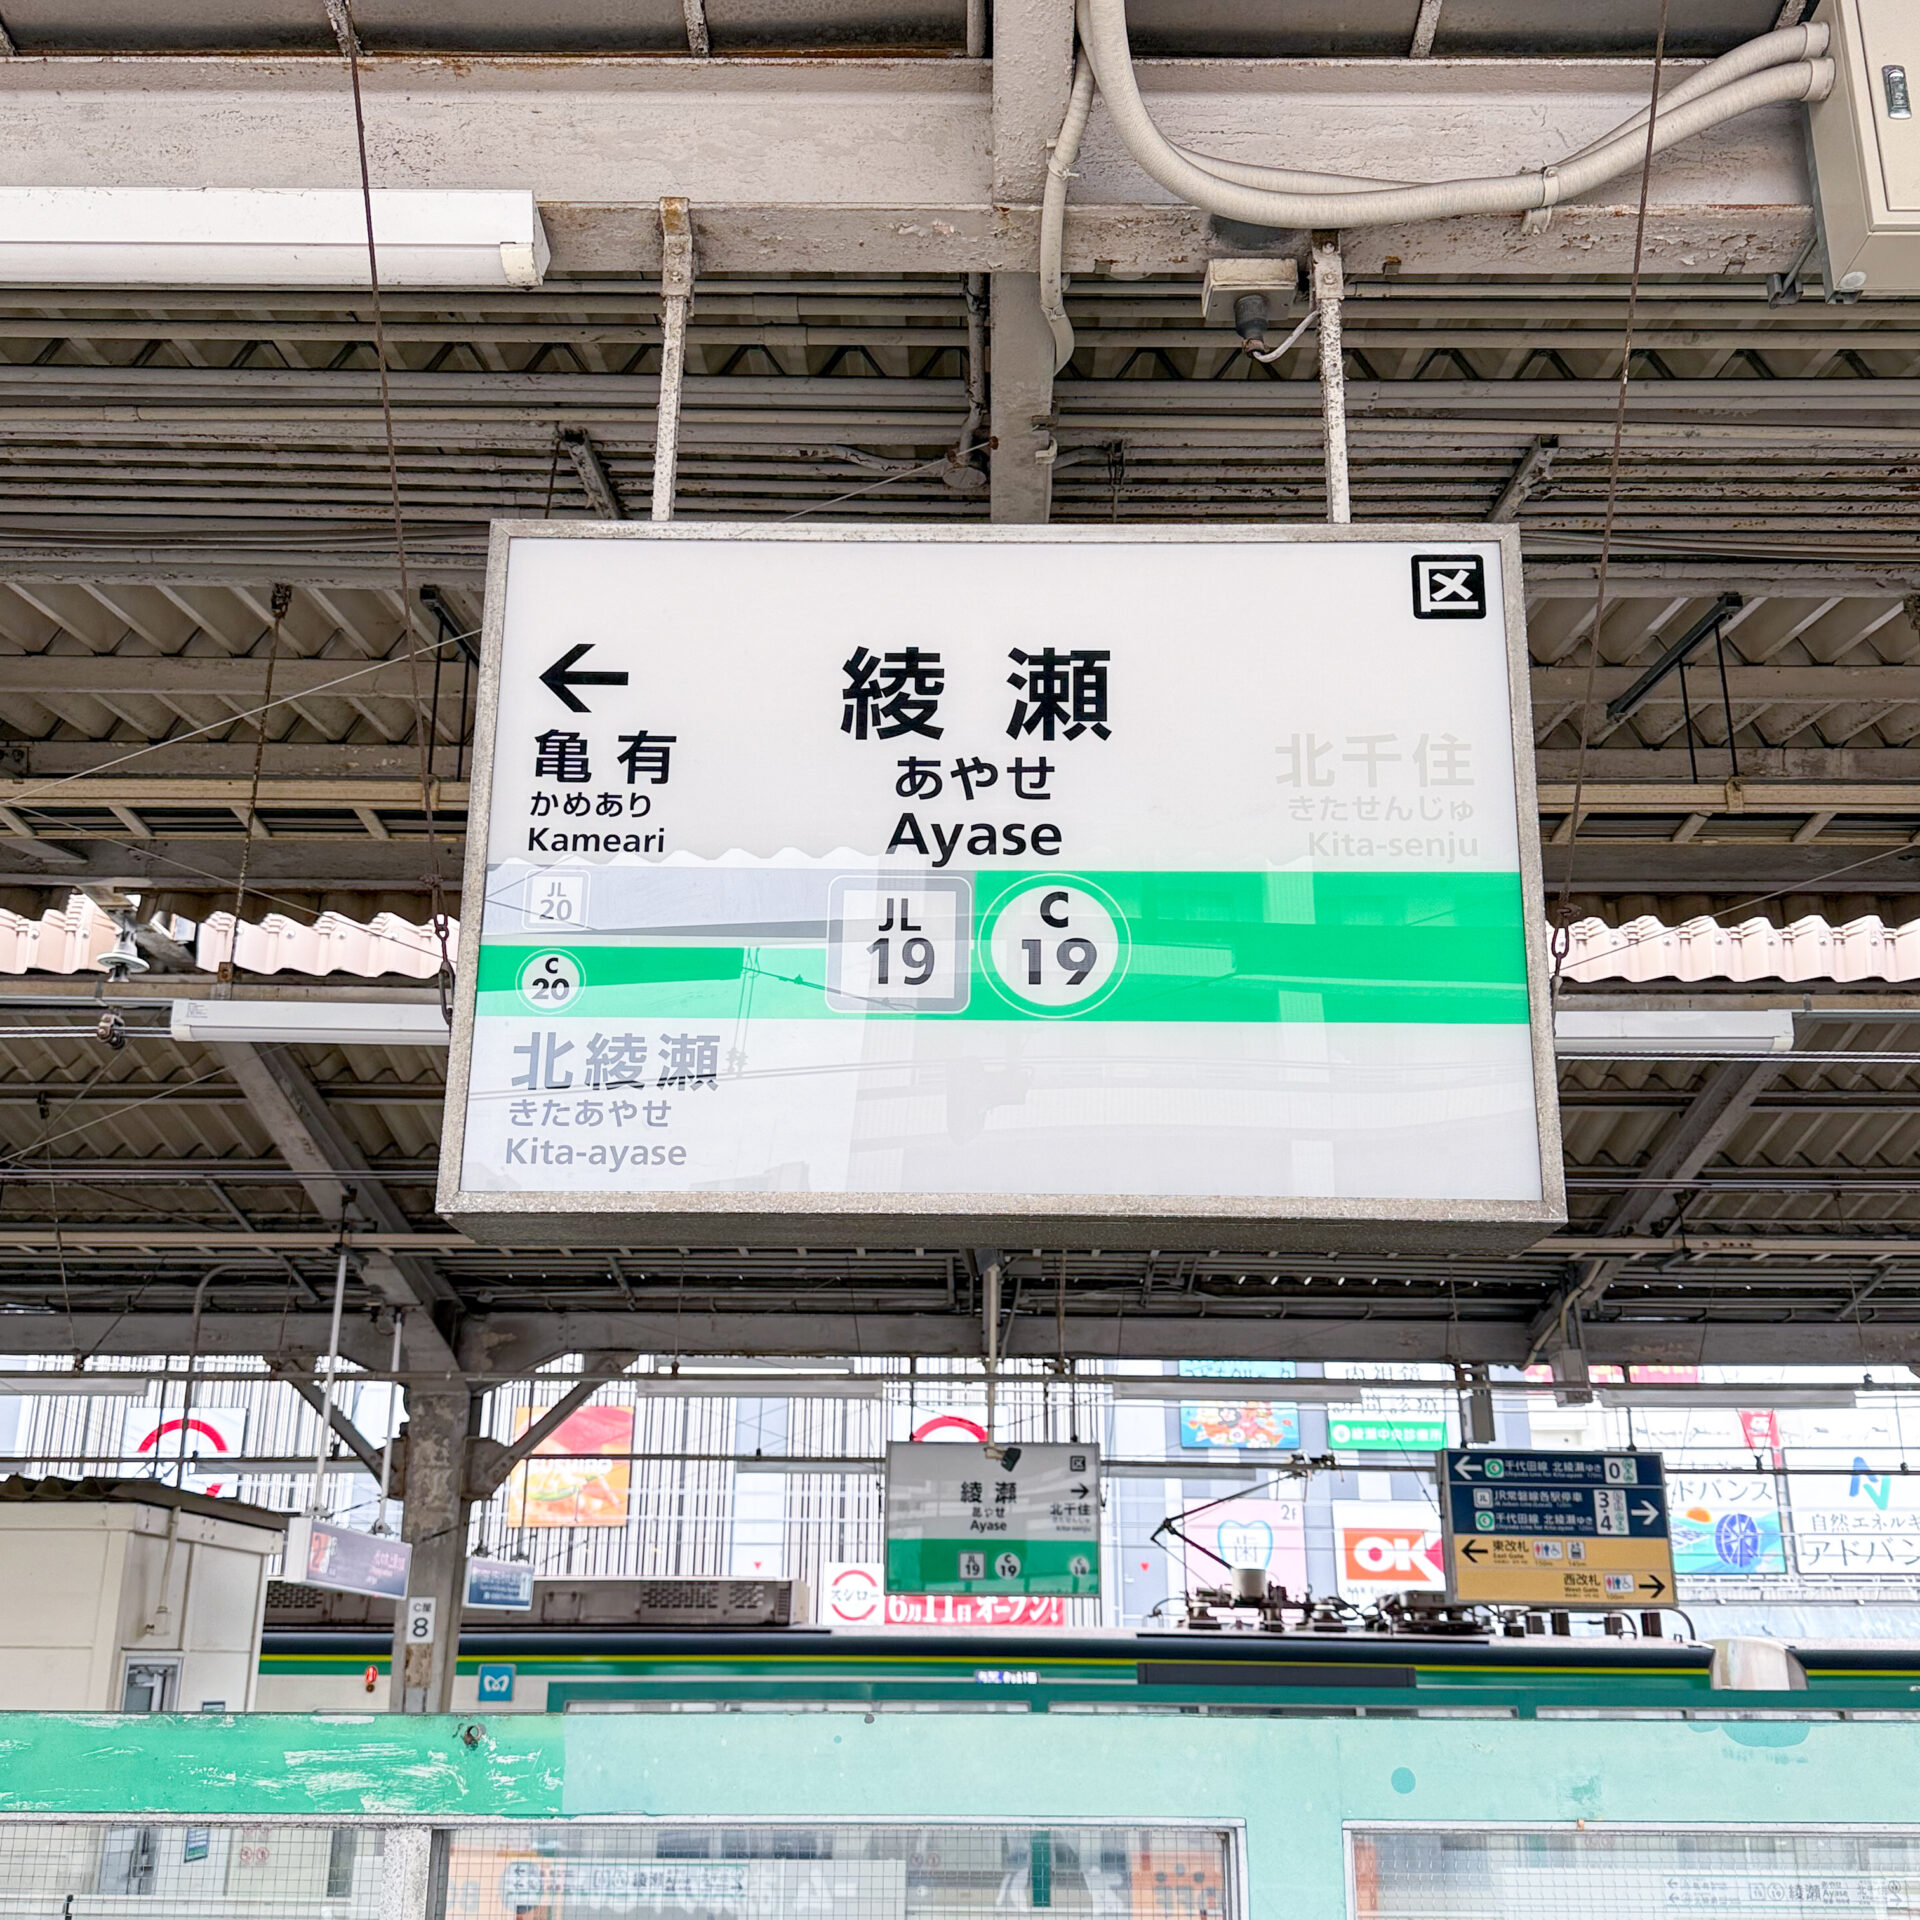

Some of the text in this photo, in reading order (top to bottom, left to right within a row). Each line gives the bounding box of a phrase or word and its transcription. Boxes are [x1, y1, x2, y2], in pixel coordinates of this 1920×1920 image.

[1415, 557, 1482, 616] 区
[840, 646, 1112, 741] 綾瀬
[534, 729, 677, 784] 亀有
[1274, 733, 1475, 788] 北千住
[895, 755, 1055, 801] あやせ
[529, 791, 651, 817] かめあり
[1288, 796, 1474, 822] きたせんじゅ
[528, 827, 665, 853] Kameari
[885, 812, 1063, 868] Ayase
[1308, 831, 1479, 863] Kita-senju
[547, 882, 567, 898] JL
[539, 899, 572, 921] 20
[878, 897, 922, 932] JL
[1040, 891, 1069, 929] C
[545, 957, 559, 974] C
[866, 937, 935, 986] 19
[1021, 937, 1098, 986] 19
[531, 978, 570, 1001] 20
[511, 1032, 721, 1092] 北綾瀬
[509, 1099, 672, 1127] きたあやせ
[505, 1137, 687, 1172] Kita-ayase
[1609, 1463, 1620, 1480] 0
[960, 1481, 1017, 1504] 綾瀬
[1665, 1479, 1773, 1502] ドバンス
[970, 1520, 1007, 1533] Ayase
[965, 1564, 980, 1576] 19
[1001, 1564, 1017, 1577] 19
[1353, 1536, 1441, 1584] OK
[413, 1617, 428, 1637] 8
